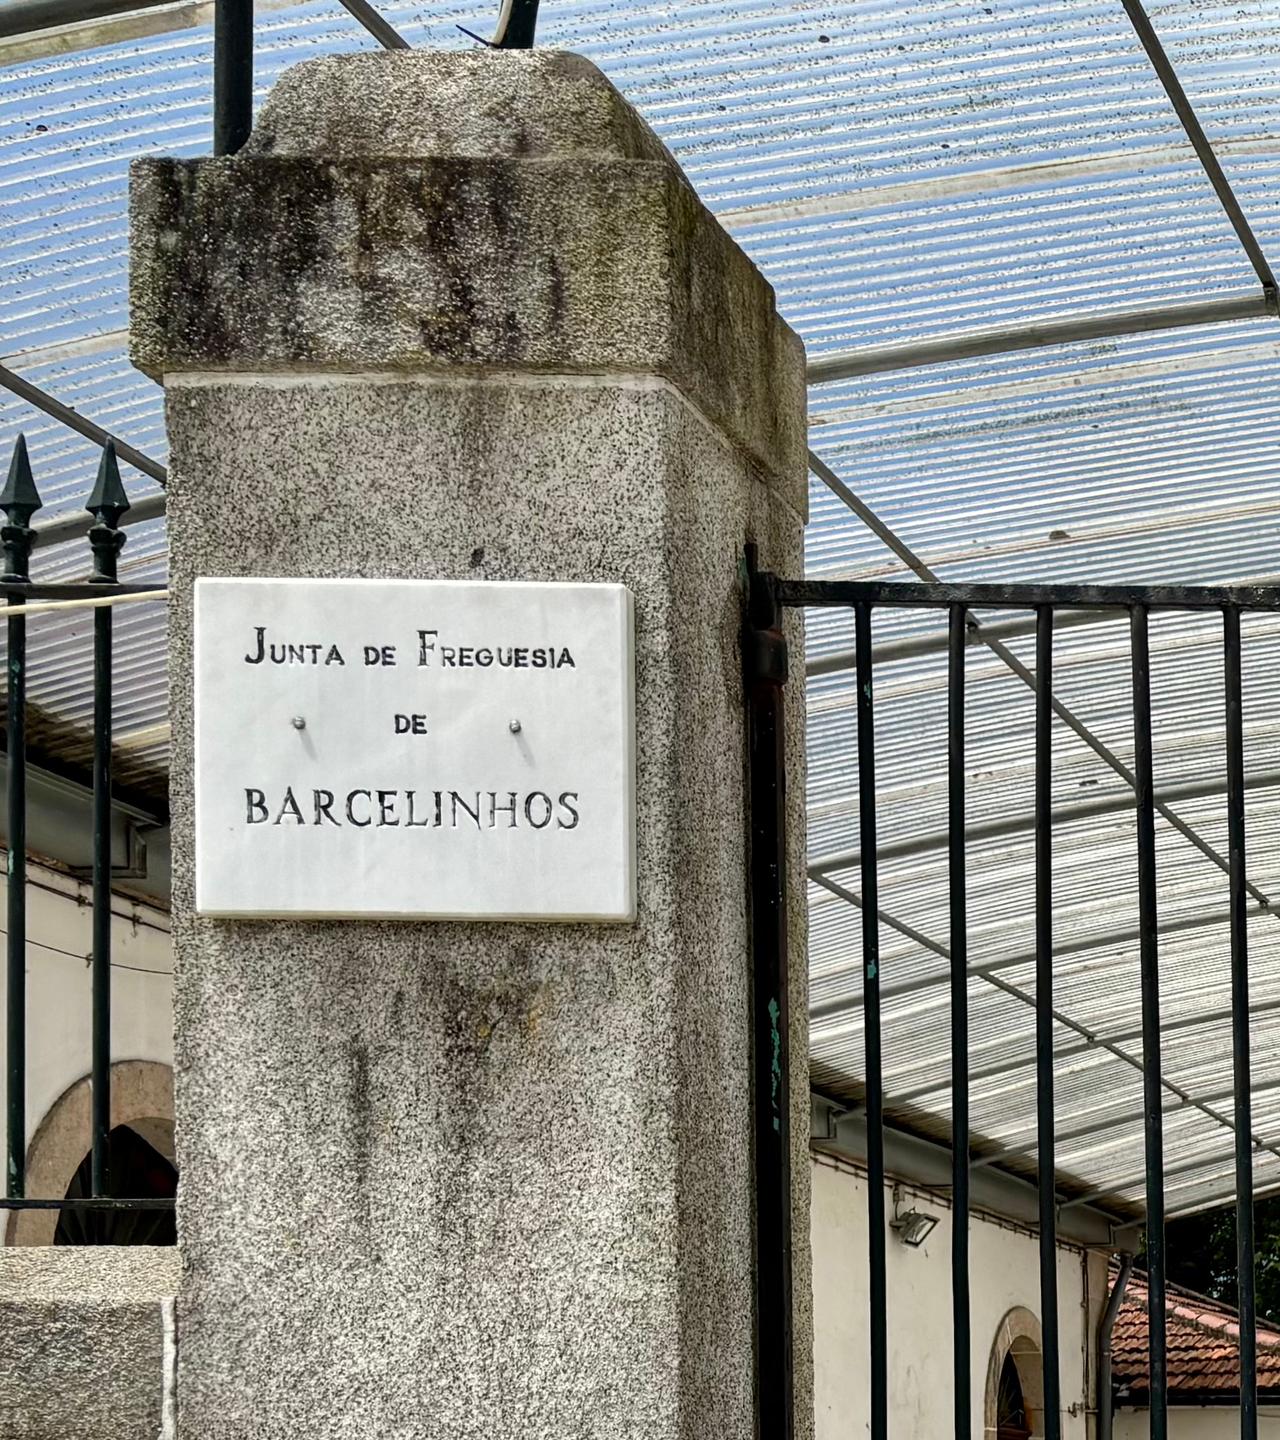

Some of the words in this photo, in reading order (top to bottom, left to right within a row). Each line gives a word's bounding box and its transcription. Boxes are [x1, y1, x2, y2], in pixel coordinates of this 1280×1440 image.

[363, 645, 397, 667] DE
[394, 713, 428, 735] DE
[243, 785, 580, 831] BARCELINHOS
